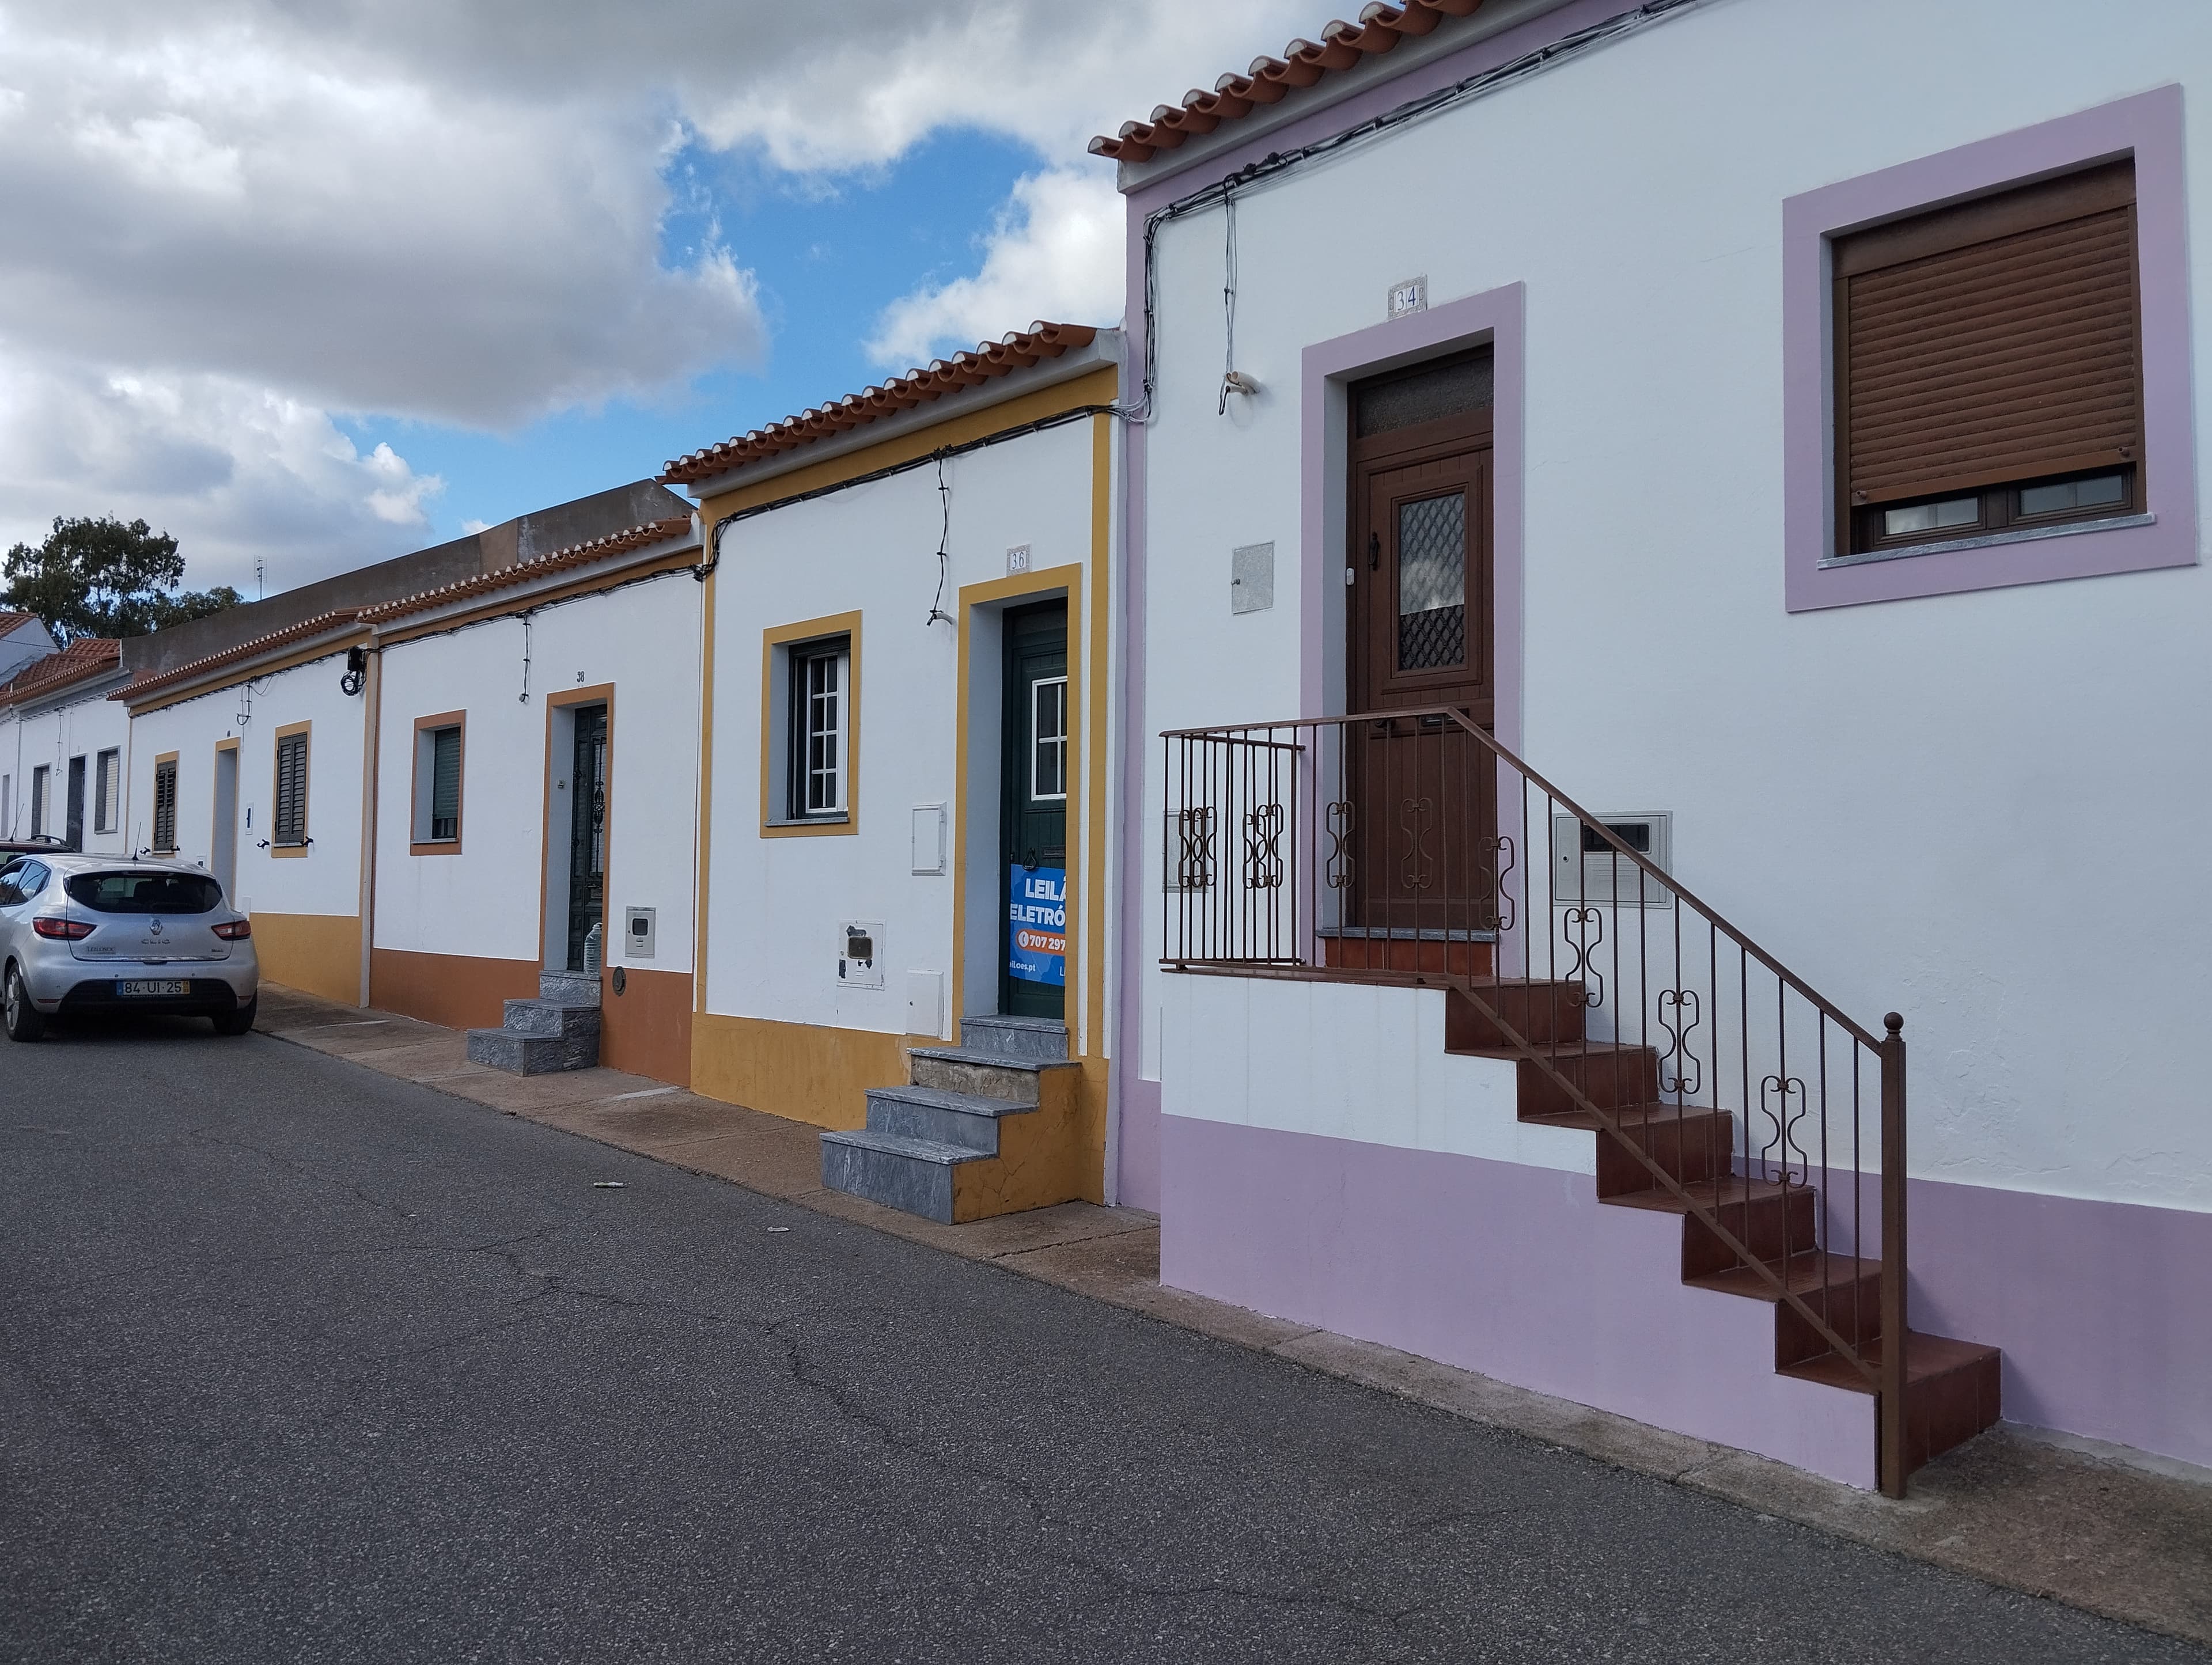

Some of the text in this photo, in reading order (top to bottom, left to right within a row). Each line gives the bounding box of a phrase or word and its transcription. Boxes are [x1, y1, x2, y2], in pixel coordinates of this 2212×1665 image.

[1397, 286, 1416, 311] 34
[1012, 552, 1024, 569] 36
[577, 671, 585, 682] 38
[1029, 935, 1066, 951] 707 297
